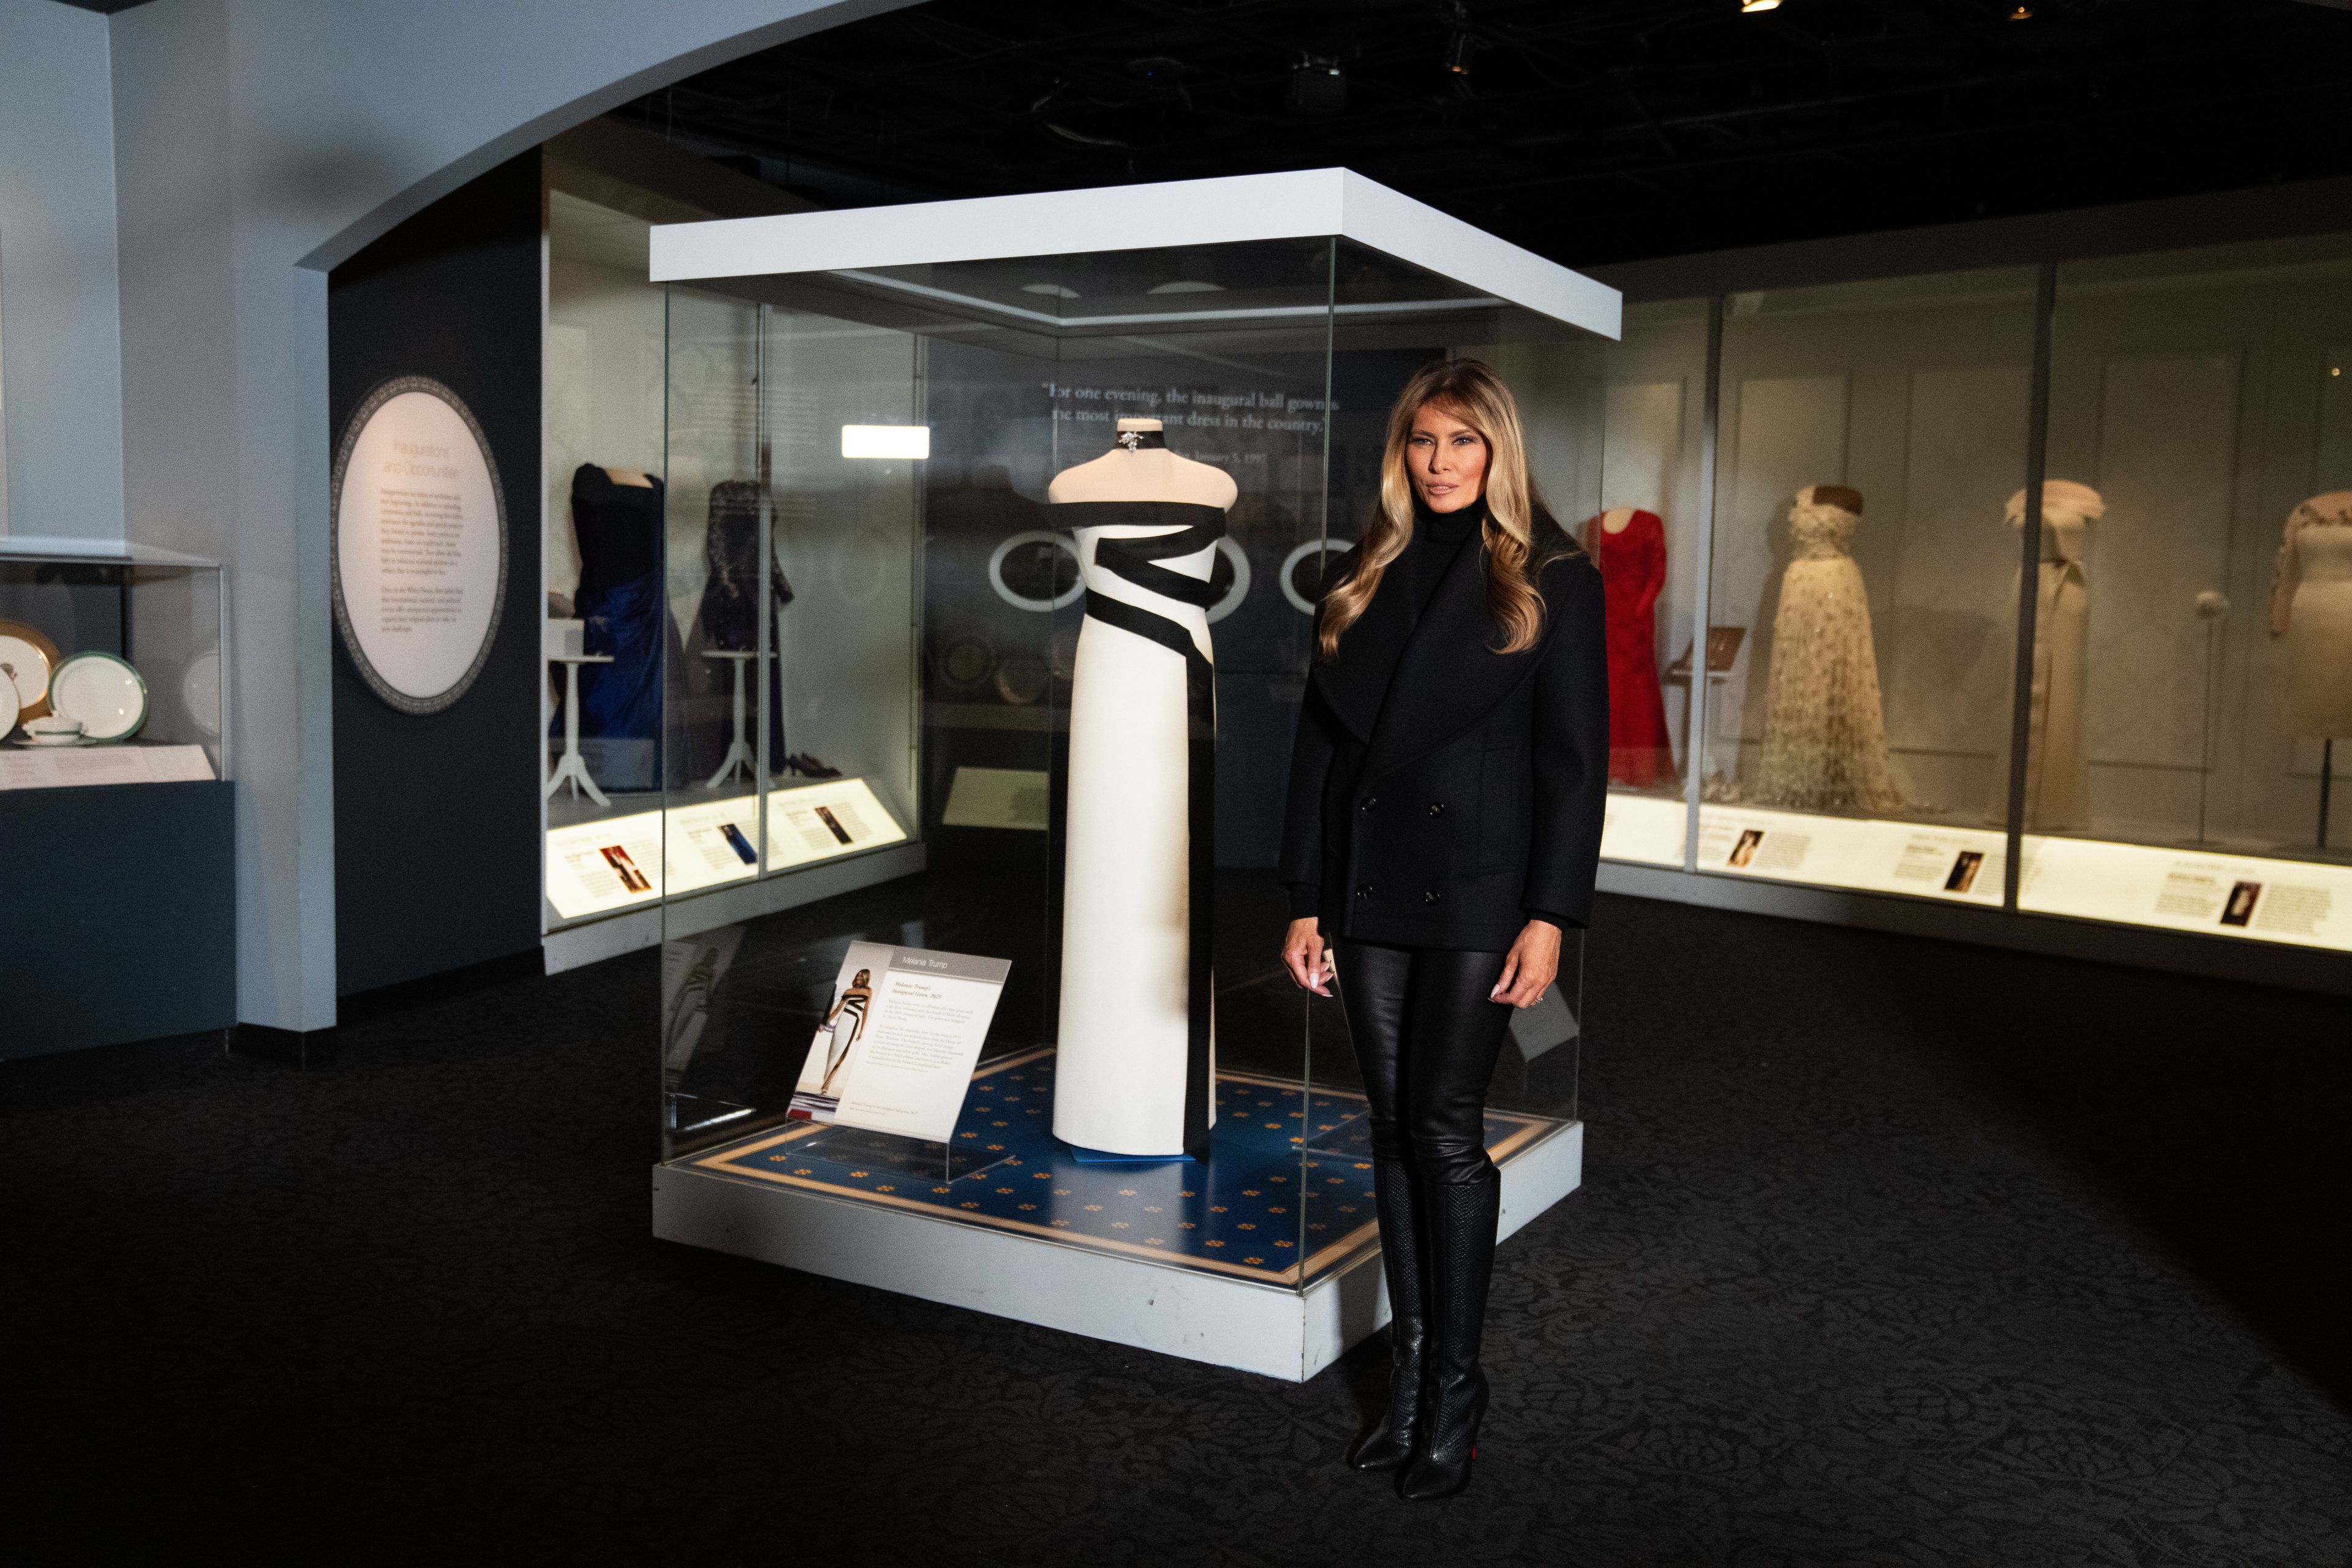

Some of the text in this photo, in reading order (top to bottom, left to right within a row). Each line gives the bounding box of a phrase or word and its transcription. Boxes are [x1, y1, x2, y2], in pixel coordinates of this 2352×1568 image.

[1075, 388, 1101, 399] one
[1104, 389, 1163, 407] evening,
[1166, 386, 1188, 404] the
[1192, 390, 1256, 410] inaugural
[1259, 392, 1284, 408] ball
[1076, 410, 1109, 422] most
[1186, 411, 1221, 427] dress
[1224, 415, 1238, 428] in
[1242, 414, 1264, 429] the
[902, 957, 948, 970] Melania Trump
